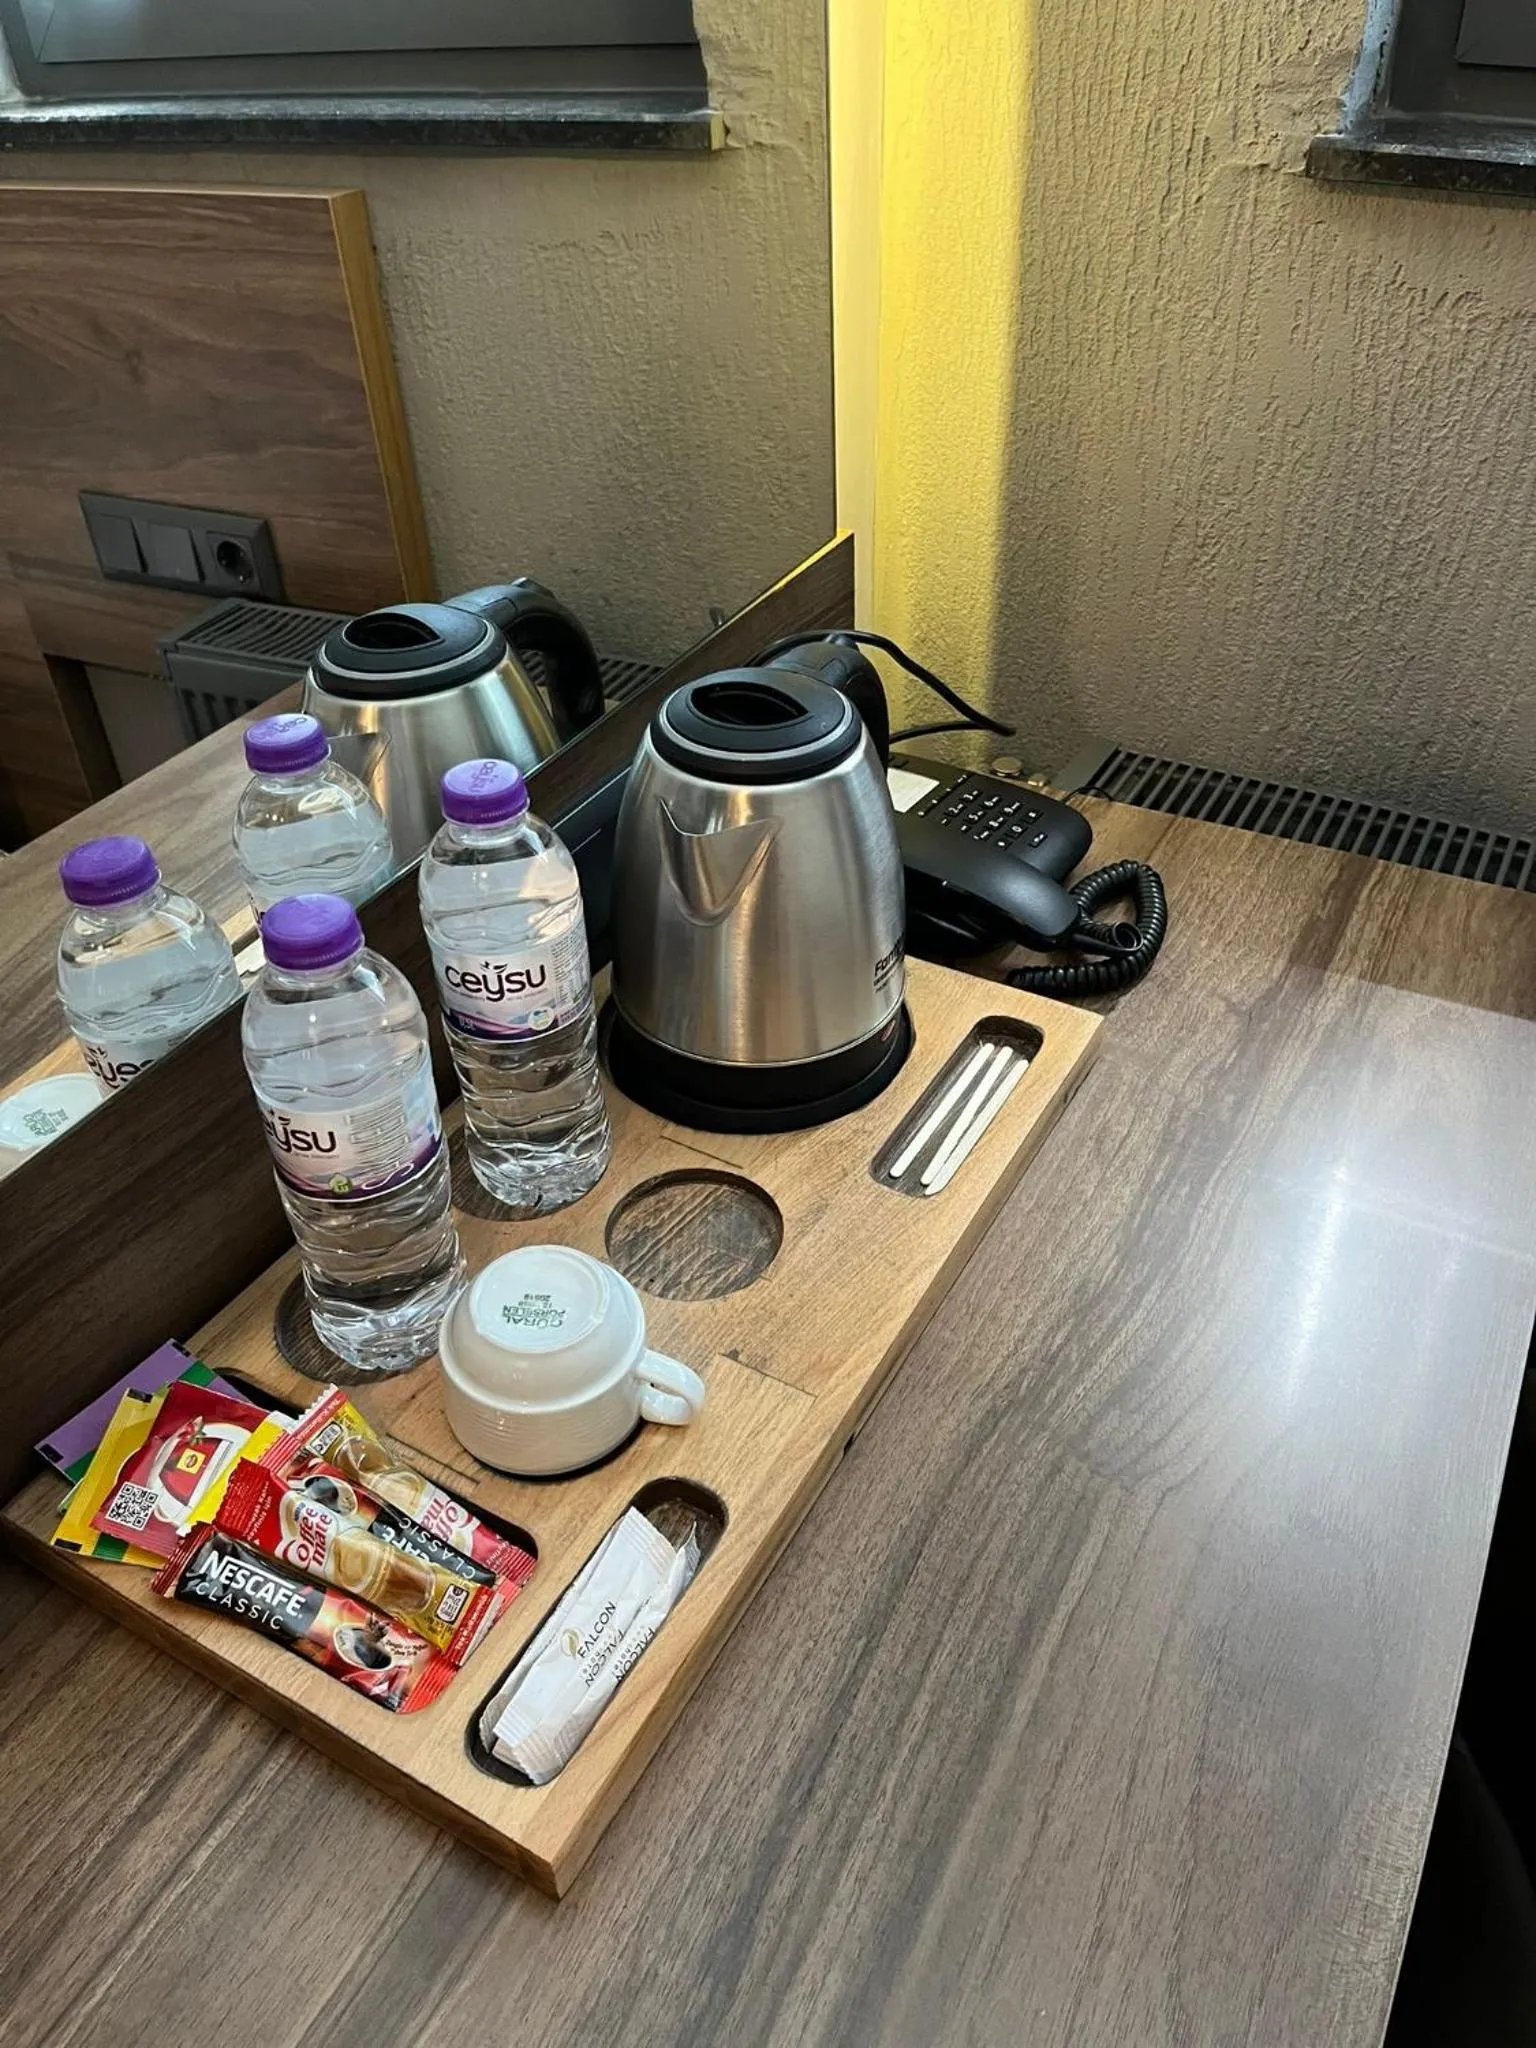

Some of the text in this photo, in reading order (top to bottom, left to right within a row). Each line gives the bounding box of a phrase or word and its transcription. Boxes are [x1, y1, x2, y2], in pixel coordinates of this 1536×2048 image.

[444, 960, 547, 1003] ceysu
[312, 1512, 333, 1567] mate
[398, 1517, 476, 1580] CLASSIC
[195, 1581, 284, 1630] CLASSIC
[576, 1600, 617, 1659] FALCON
[584, 1628, 625, 1688] FALCON
